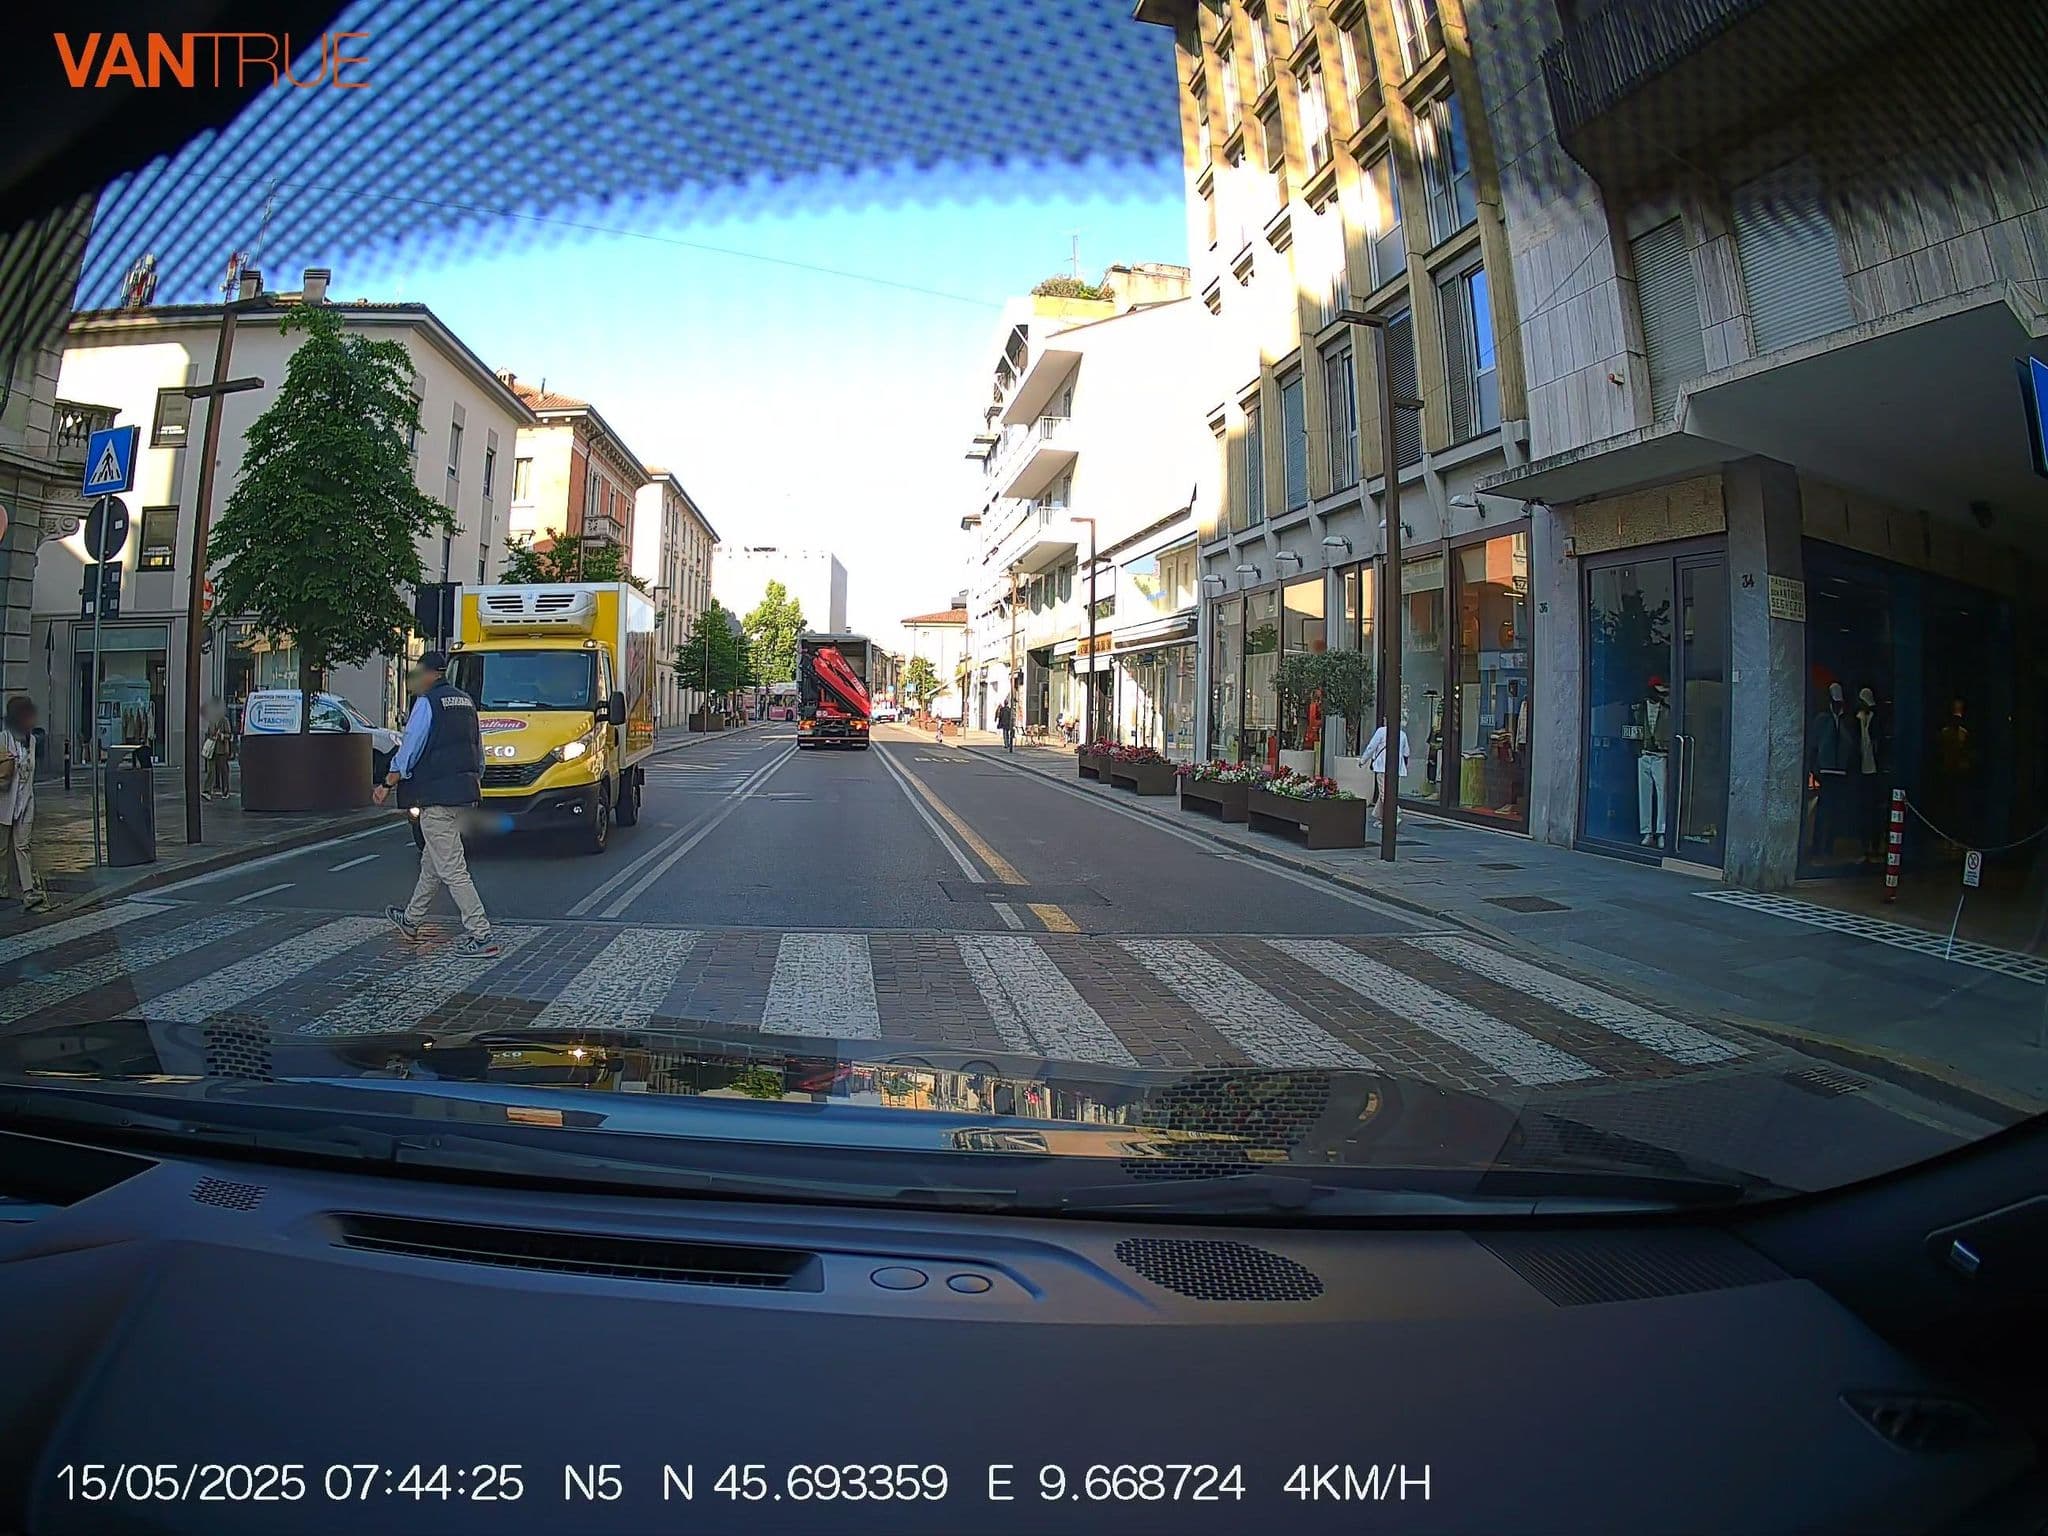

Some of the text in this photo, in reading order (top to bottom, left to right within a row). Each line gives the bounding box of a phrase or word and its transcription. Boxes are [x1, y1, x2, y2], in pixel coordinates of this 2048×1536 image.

[1742, 573, 1754, 588] 34
[480, 720, 522, 728] albani
[485, 745, 515, 757] ECO
